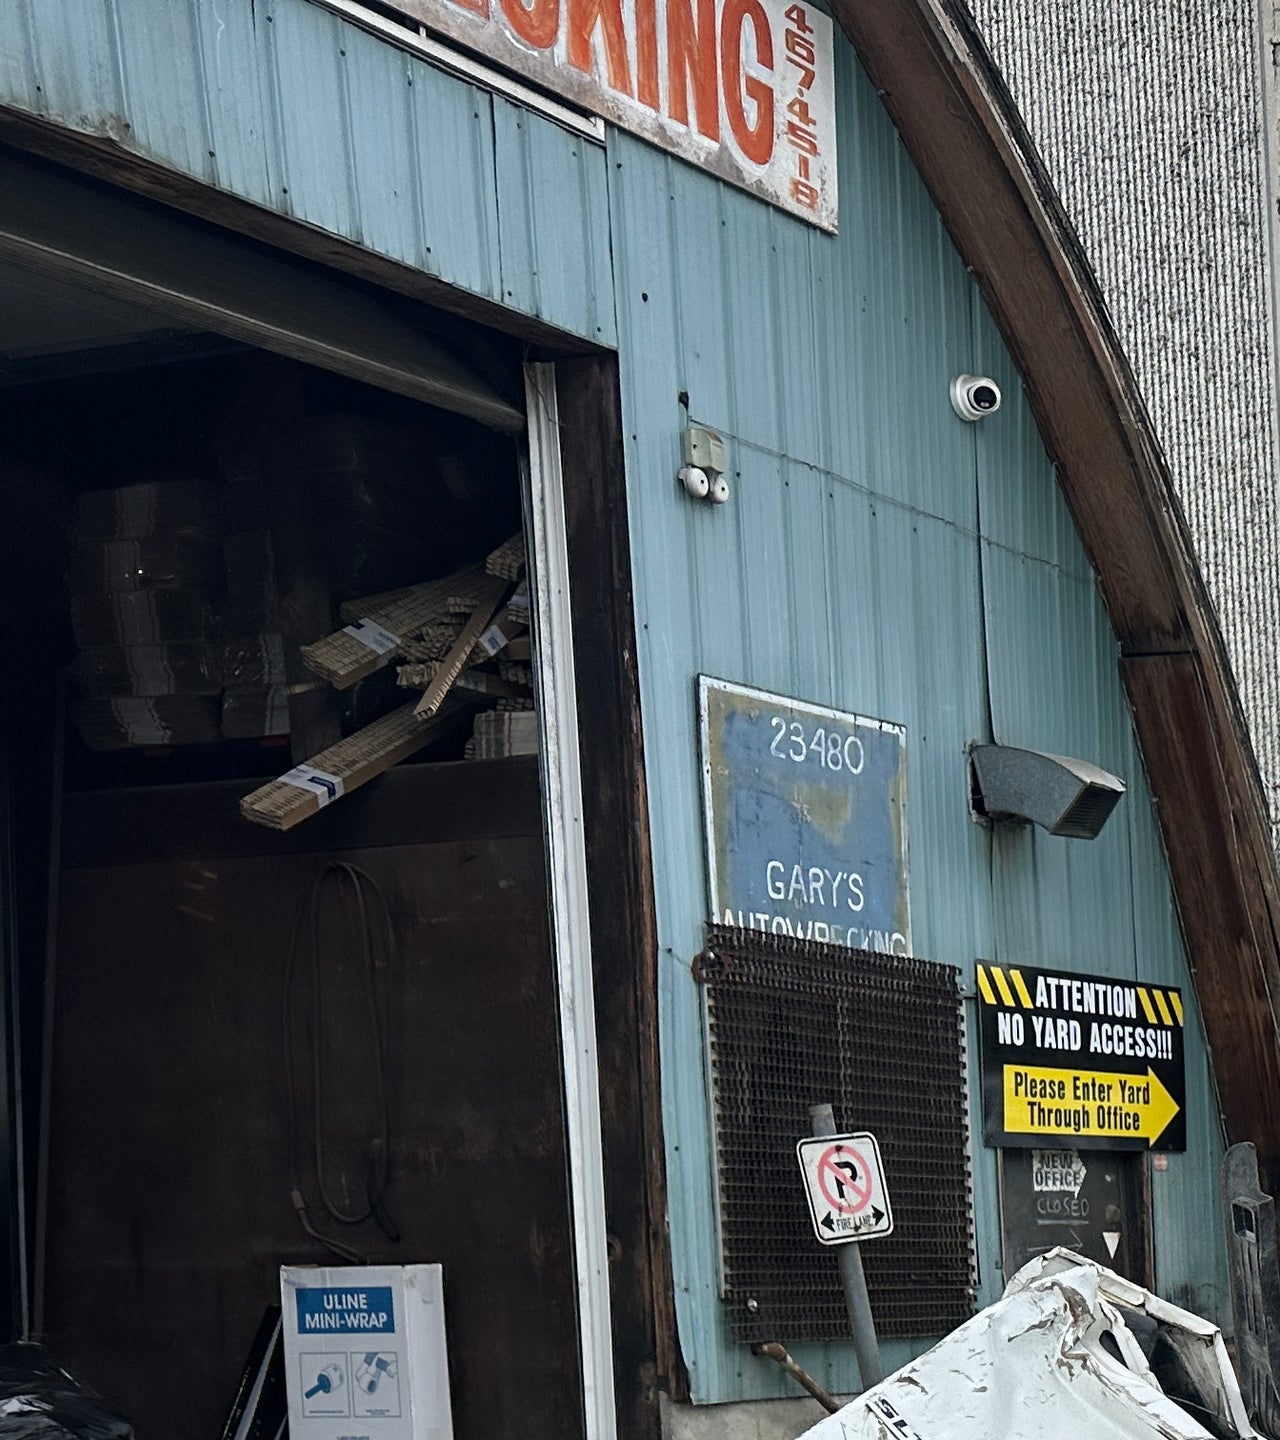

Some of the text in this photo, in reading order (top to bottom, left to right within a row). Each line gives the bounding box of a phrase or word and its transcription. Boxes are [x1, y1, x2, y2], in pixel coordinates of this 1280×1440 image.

[769, 716, 865, 775] 23480
[766, 859, 865, 912] GARY'S
[1036, 975, 1138, 1019] ATTENTION
[997, 1011, 1173, 1060] NO YARD ACCESS!!!
[1014, 1071, 1150, 1105] Please Enter Yard
[1027, 1101, 1140, 1132] Through Office
[1039, 1152, 1073, 1170] NEW
[1034, 1168, 1083, 1188] OFFICE
[1036, 1197, 1090, 1217] CLOSED
[836, 1217, 852, 1231] FIRE
[323, 1293, 368, 1310] ULINE
[305, 1311, 388, 1330] MINI-WRAP
